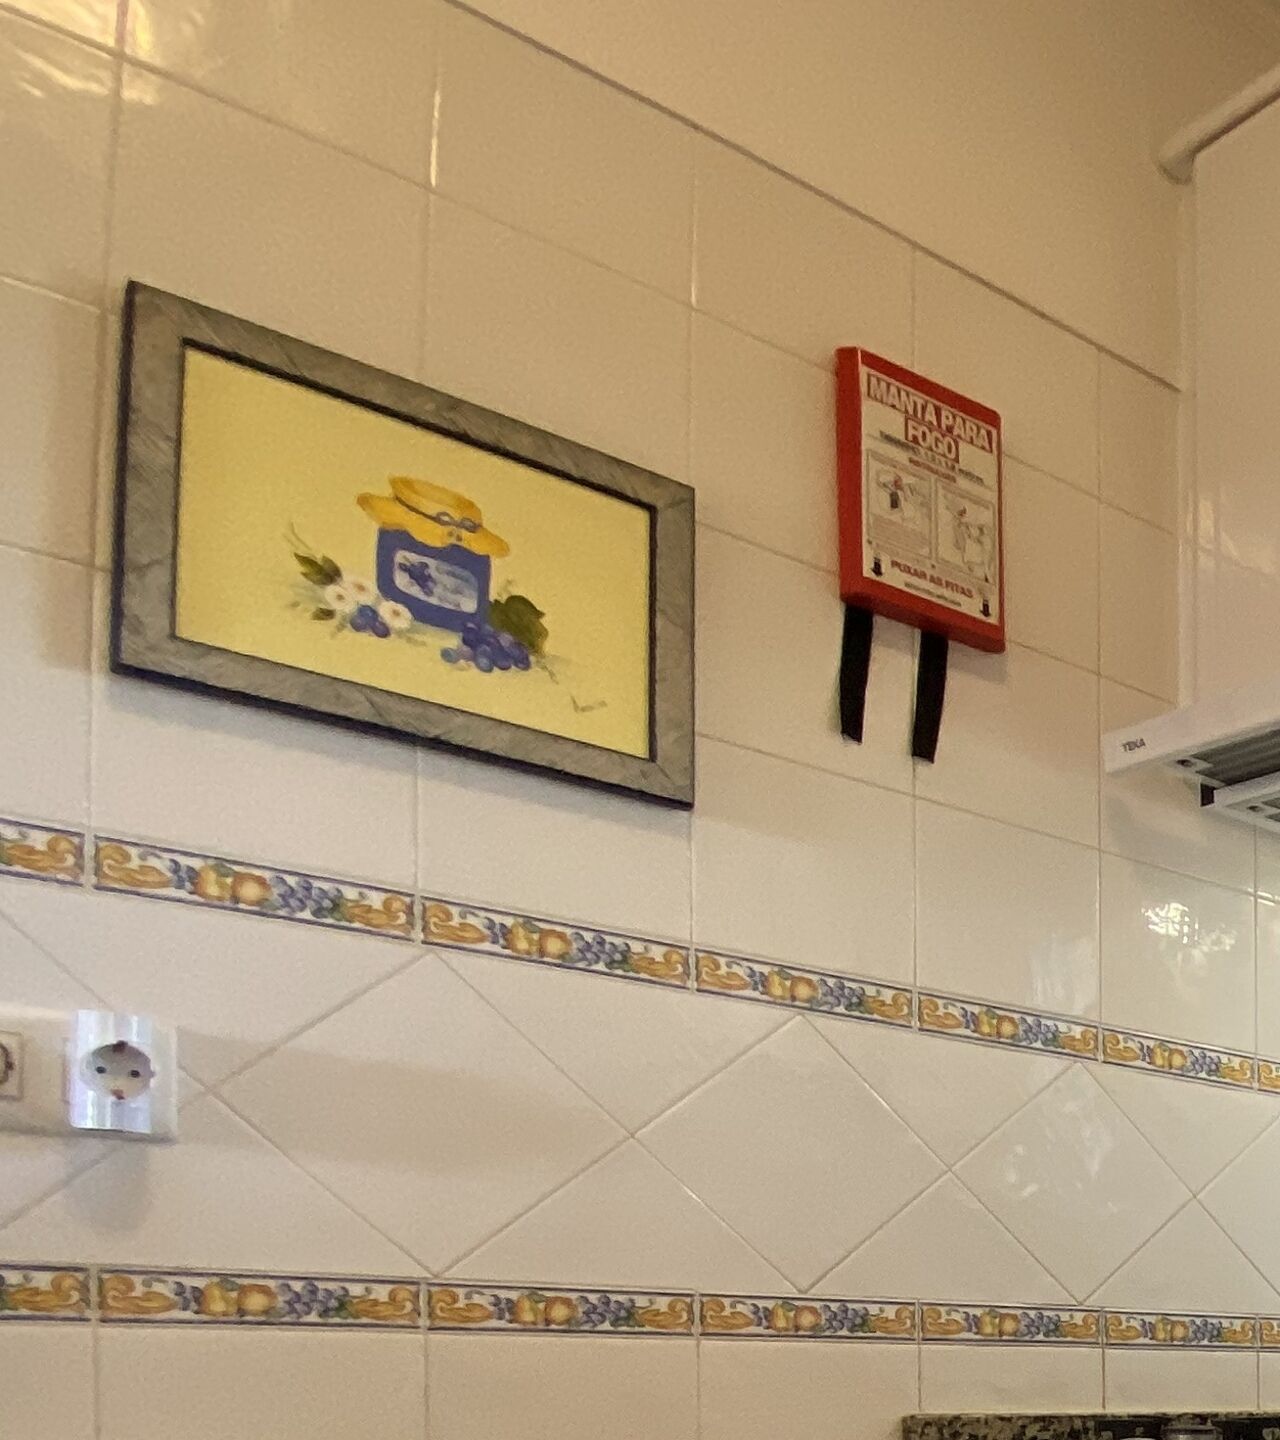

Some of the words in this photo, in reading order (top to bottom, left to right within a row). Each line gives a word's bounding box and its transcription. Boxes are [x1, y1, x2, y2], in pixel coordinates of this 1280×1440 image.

[869, 375, 938, 427] MANTA
[941, 406, 991, 452] PARA
[907, 418, 957, 460] FOGO
